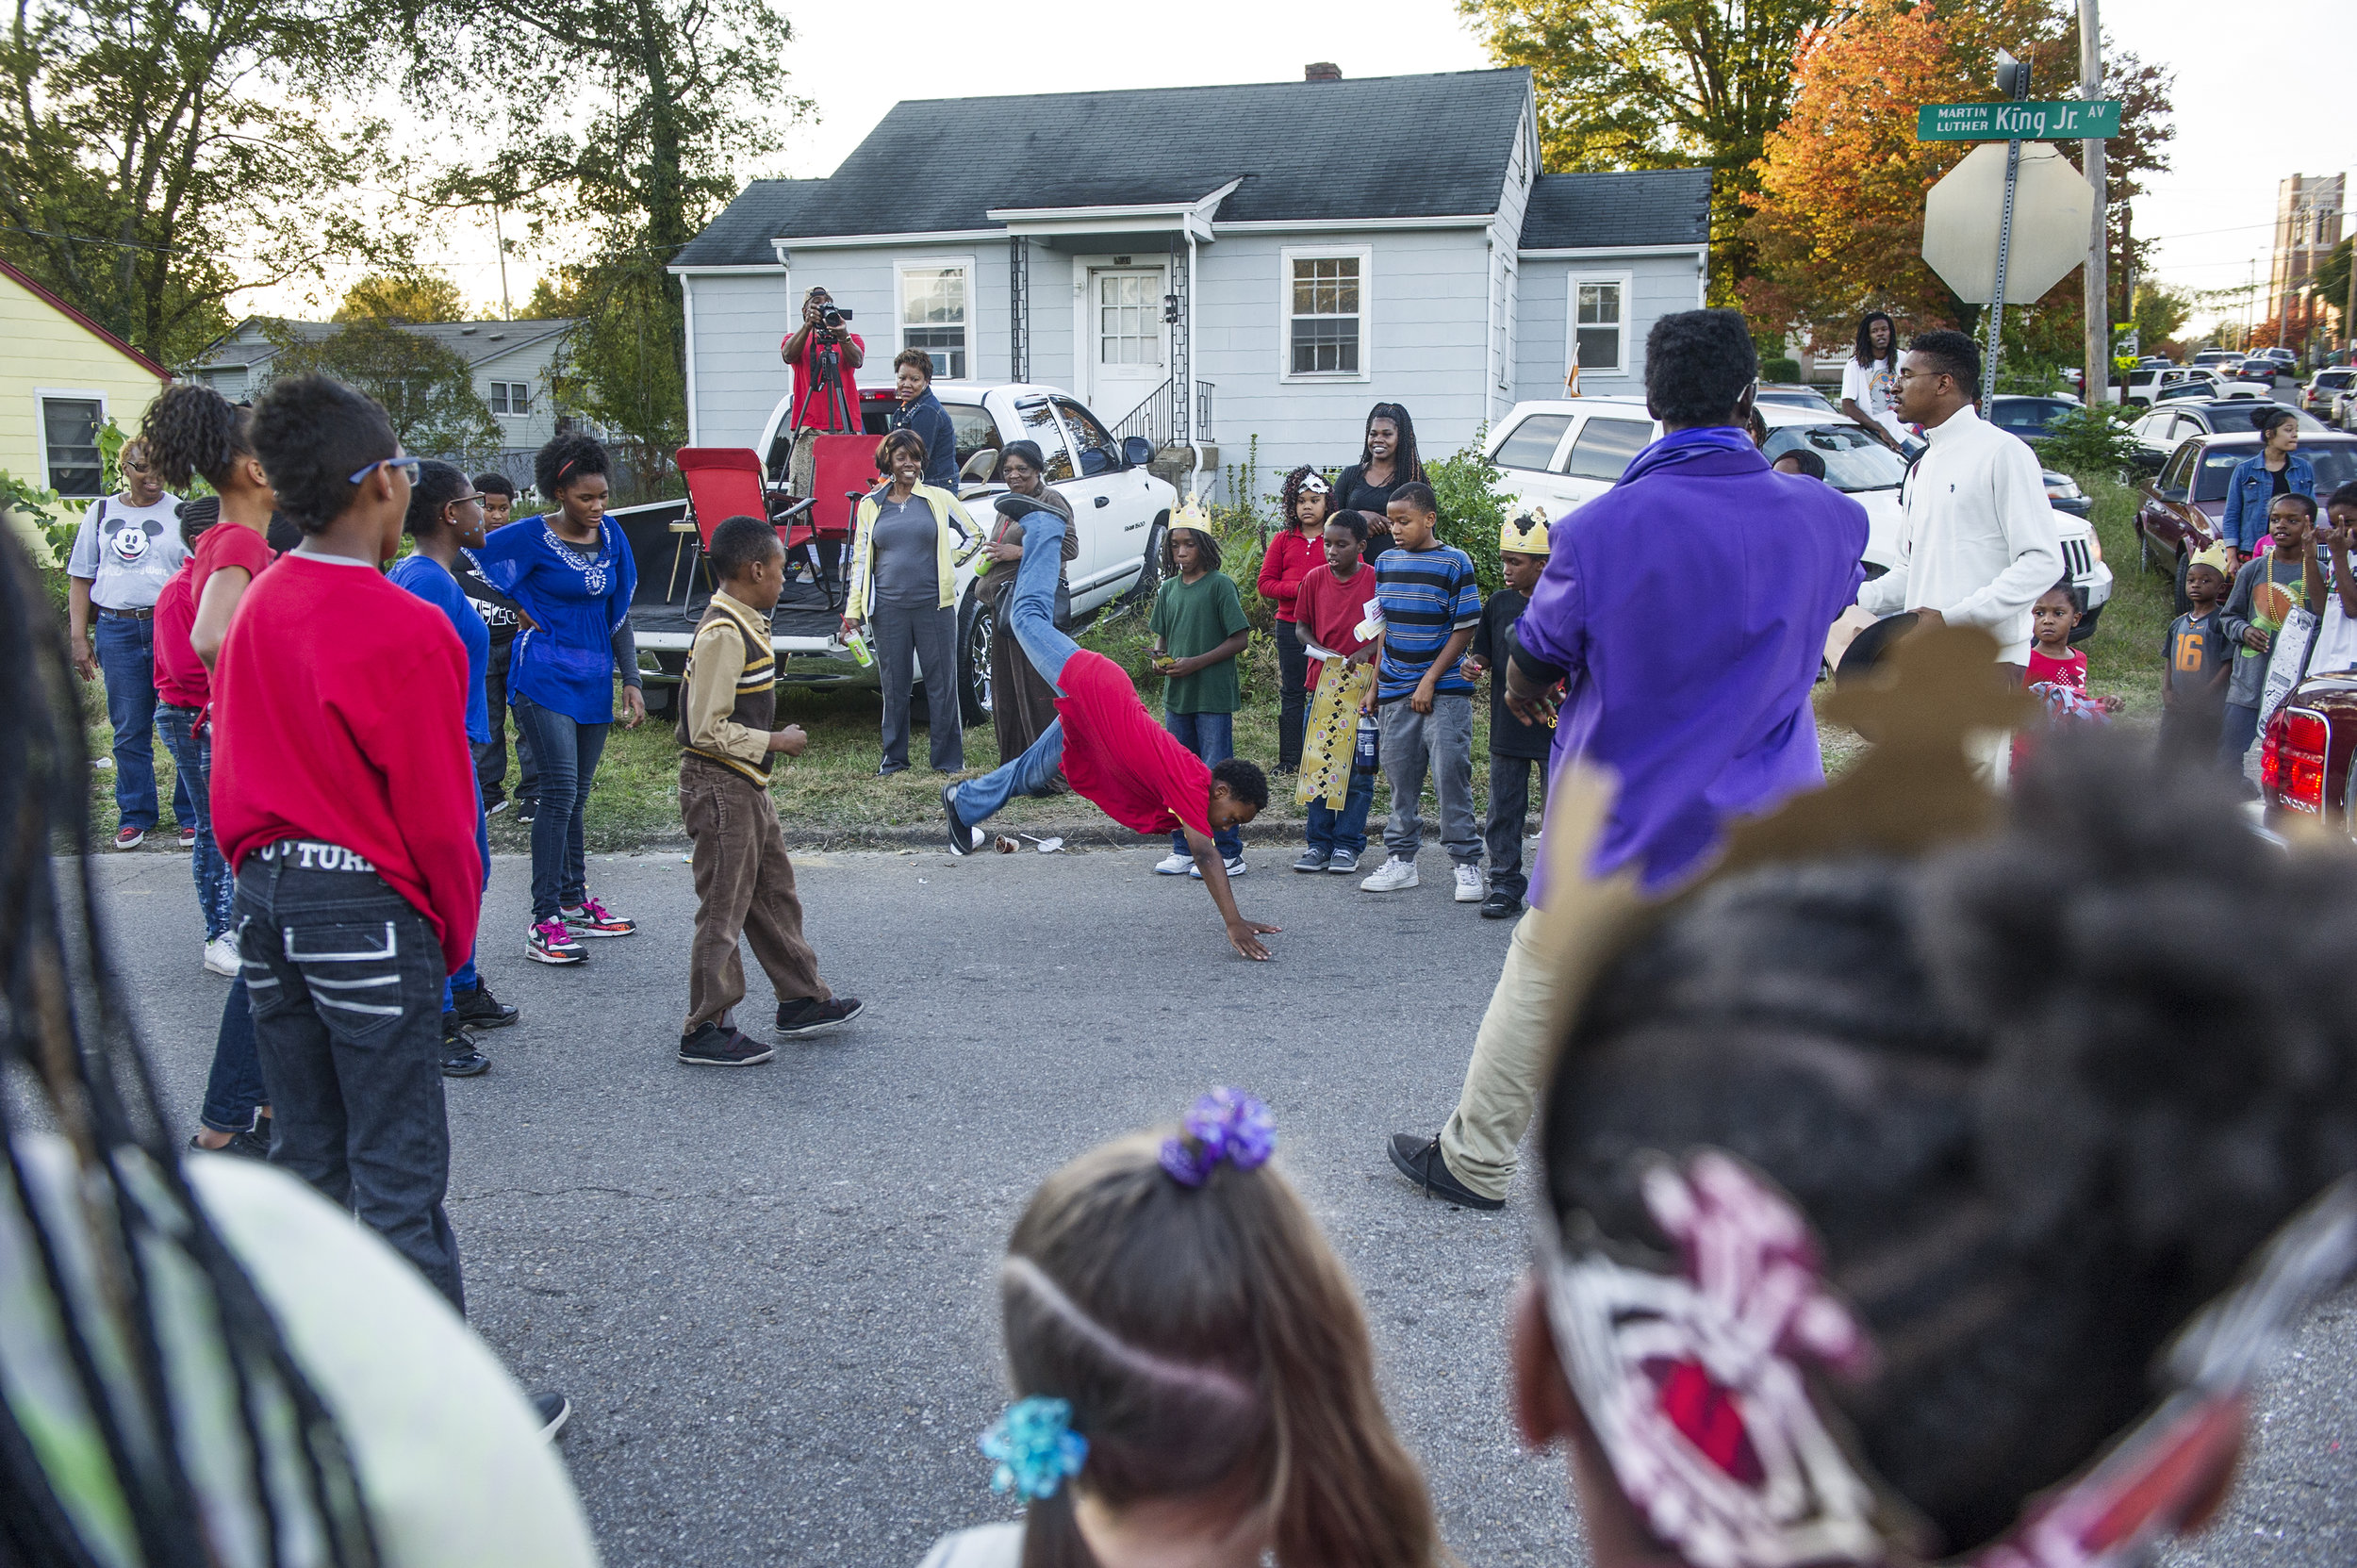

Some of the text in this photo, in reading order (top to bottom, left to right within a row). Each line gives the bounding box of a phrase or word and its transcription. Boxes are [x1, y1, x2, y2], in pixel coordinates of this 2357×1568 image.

[1937, 107, 1987, 119] MARTIN
[1995, 106, 2105, 138] King Jr. AV
[1937, 121, 1988, 132] LUTHER
[2176, 634, 2203, 671] 16
[2279, 793, 2317, 815] LINCOLN
